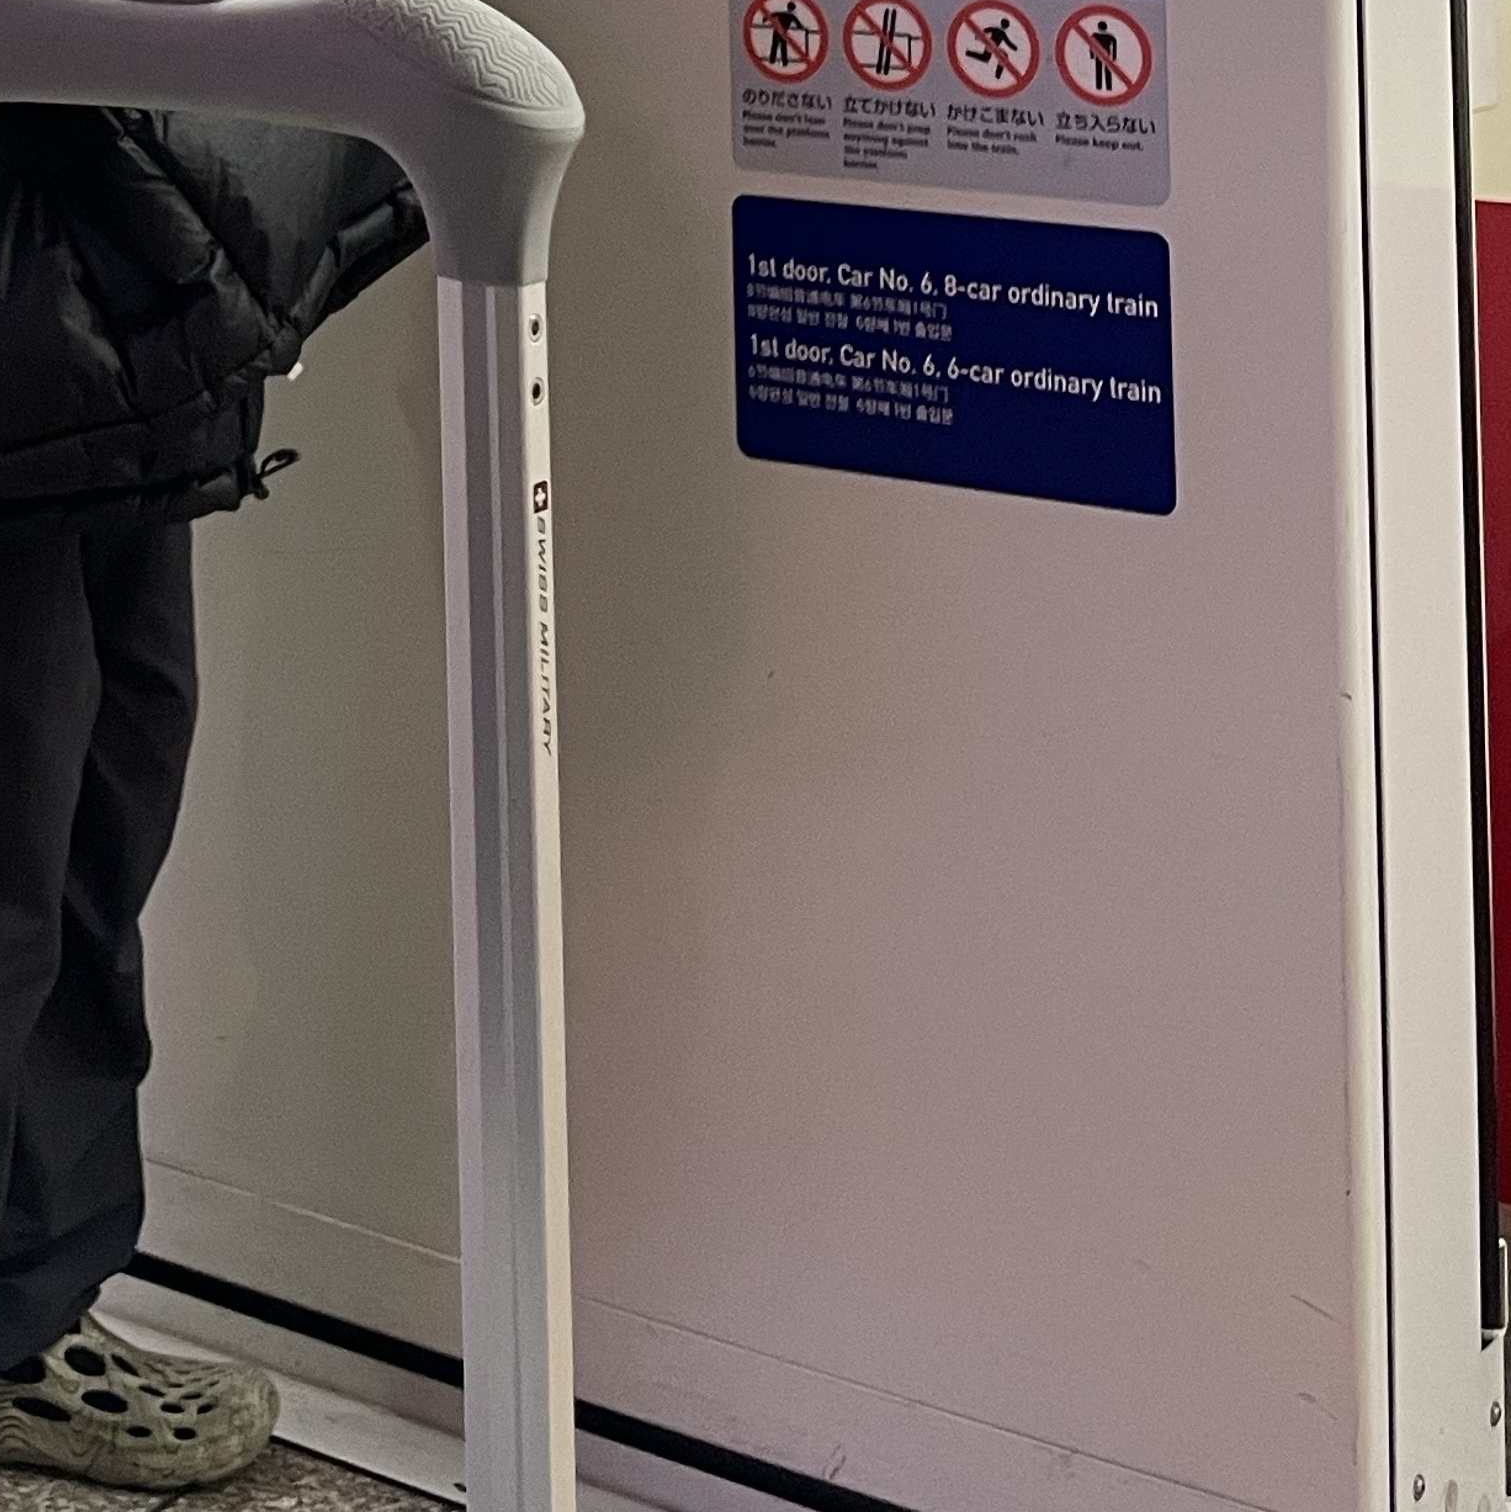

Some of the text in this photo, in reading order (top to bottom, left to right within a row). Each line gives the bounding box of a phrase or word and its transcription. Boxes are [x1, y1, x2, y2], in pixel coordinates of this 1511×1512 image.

[946, 103, 1045, 127] かけこまない
[1055, 110, 1156, 134] 立ち入らない
[748, 252, 776, 278] 1st
[838, 262, 874, 288] Car
[944, 274, 1002, 301] 8-car
[1008, 283, 1101, 318] ordinary
[1107, 291, 1159, 318] train
[750, 333, 779, 358] 1st
[840, 343, 876, 369] Car
[947, 356, 1005, 385] 6-car
[1010, 367, 1104, 403] ordinary
[1110, 376, 1162, 405] train
[539, 620, 552, 758] MILITARY
